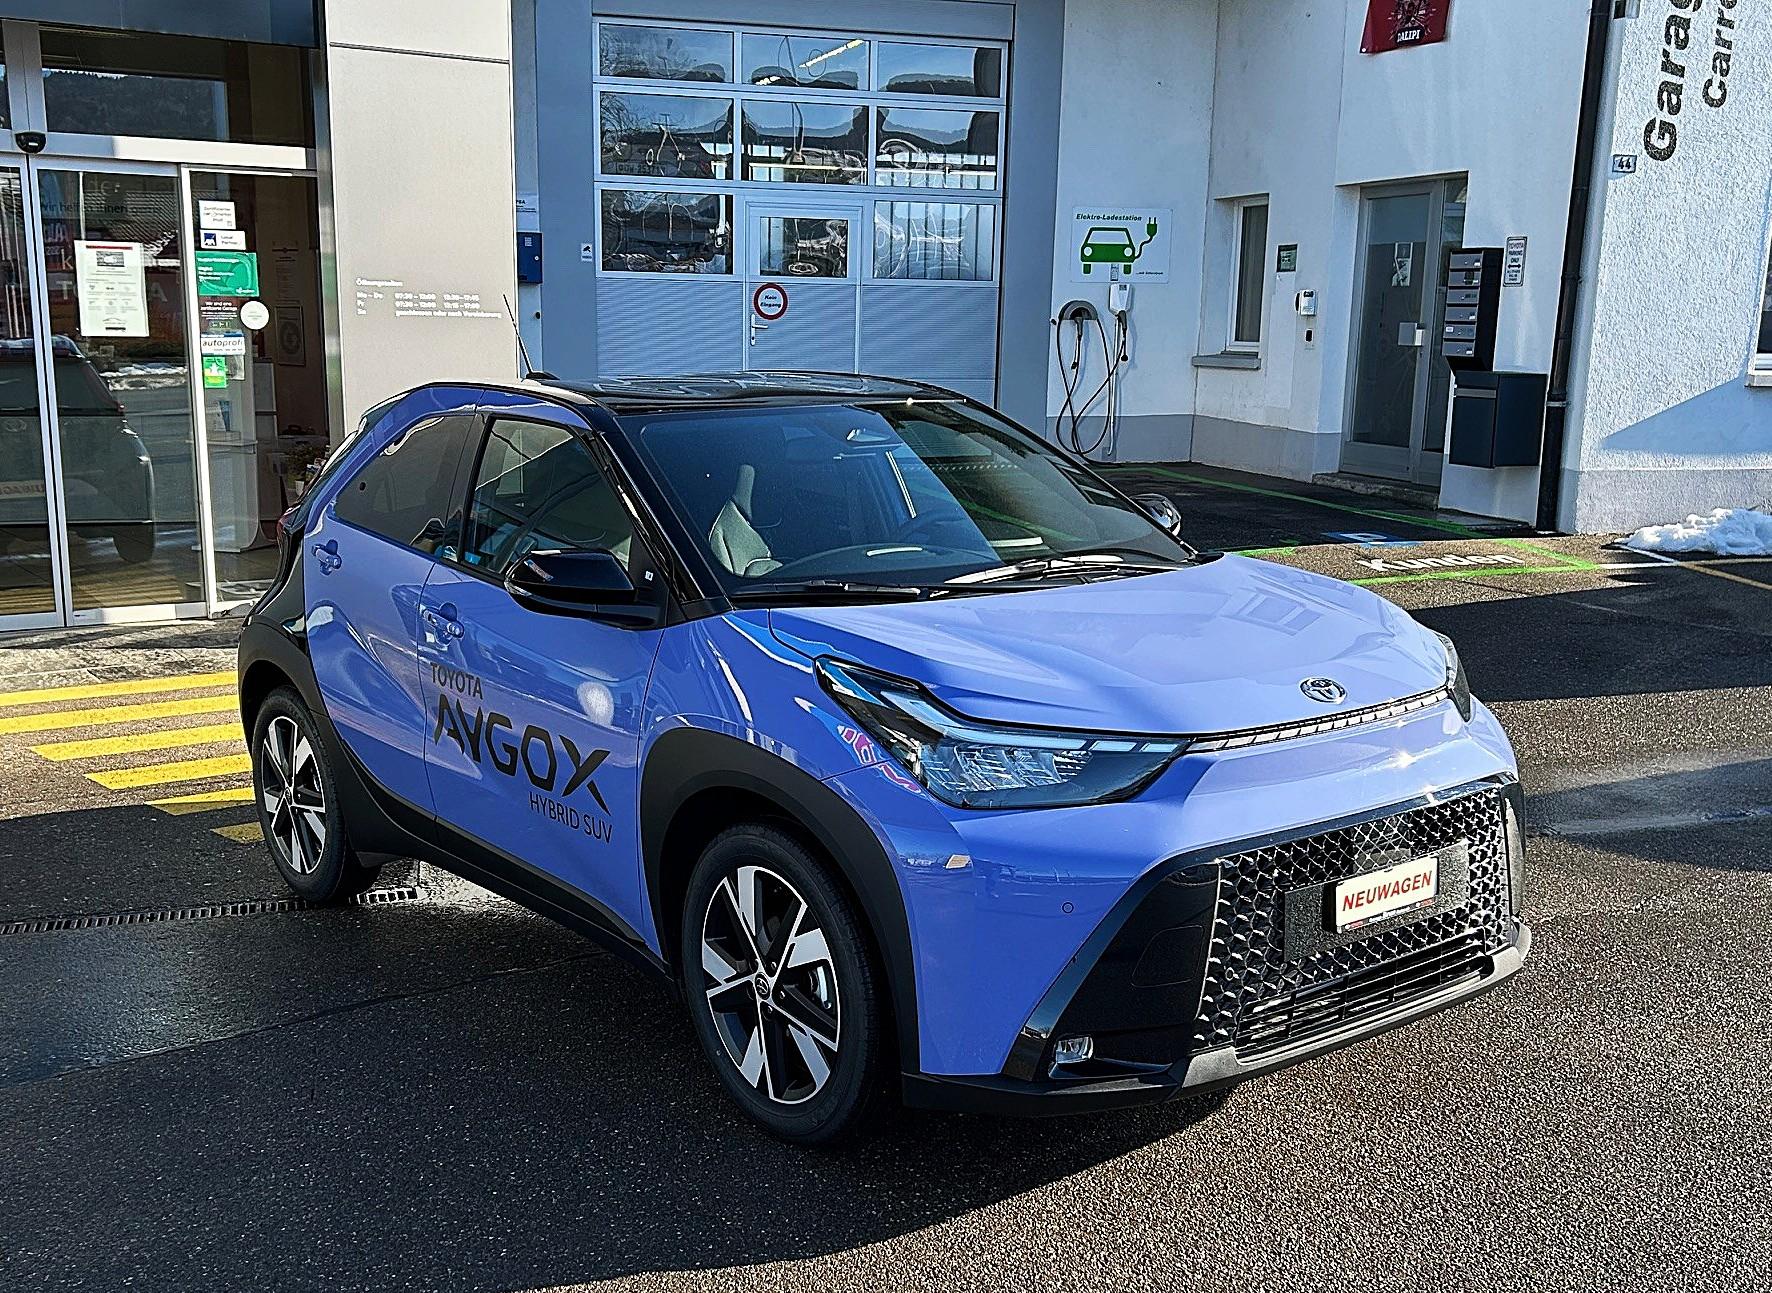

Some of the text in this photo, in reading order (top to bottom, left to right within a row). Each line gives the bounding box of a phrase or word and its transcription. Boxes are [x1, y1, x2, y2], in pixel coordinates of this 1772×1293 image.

[1617, 160, 1632, 170] 44
[1075, 213, 1142, 221] Elektro-Ladestation
[202, 339, 243, 348] autoprofi
[1355, 554, 1527, 572] Kunden
[430, 662, 484, 700] TOYOTA
[529, 791, 613, 844] HYBRID SUV
[1342, 870, 1432, 912] NEUWAGEN
